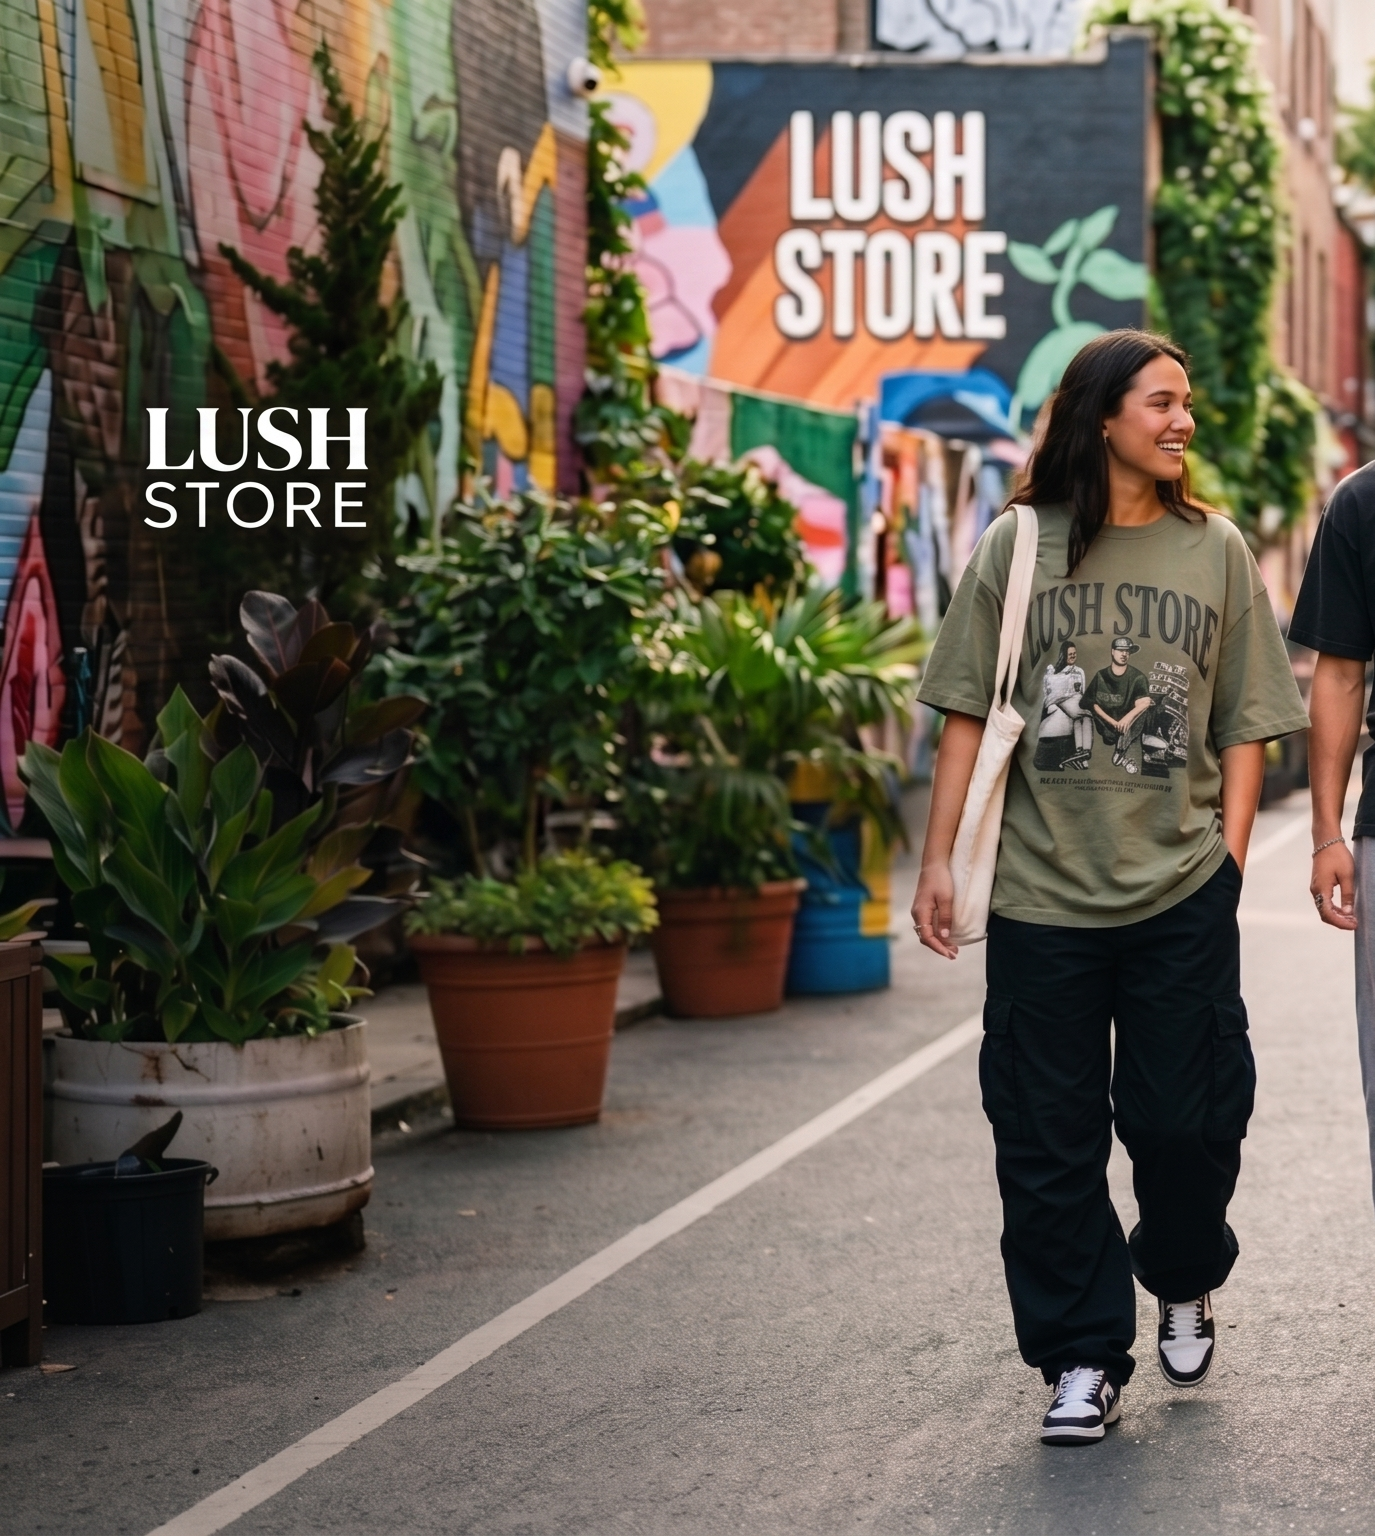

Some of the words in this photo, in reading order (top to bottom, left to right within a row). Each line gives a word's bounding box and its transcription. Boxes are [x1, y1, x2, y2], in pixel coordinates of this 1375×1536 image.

[788, 109, 987, 223] LUSH
[773, 228, 1008, 341] STORE
[1025, 582, 1105, 670] LUSH
[1113, 582, 1219, 681] STORE
